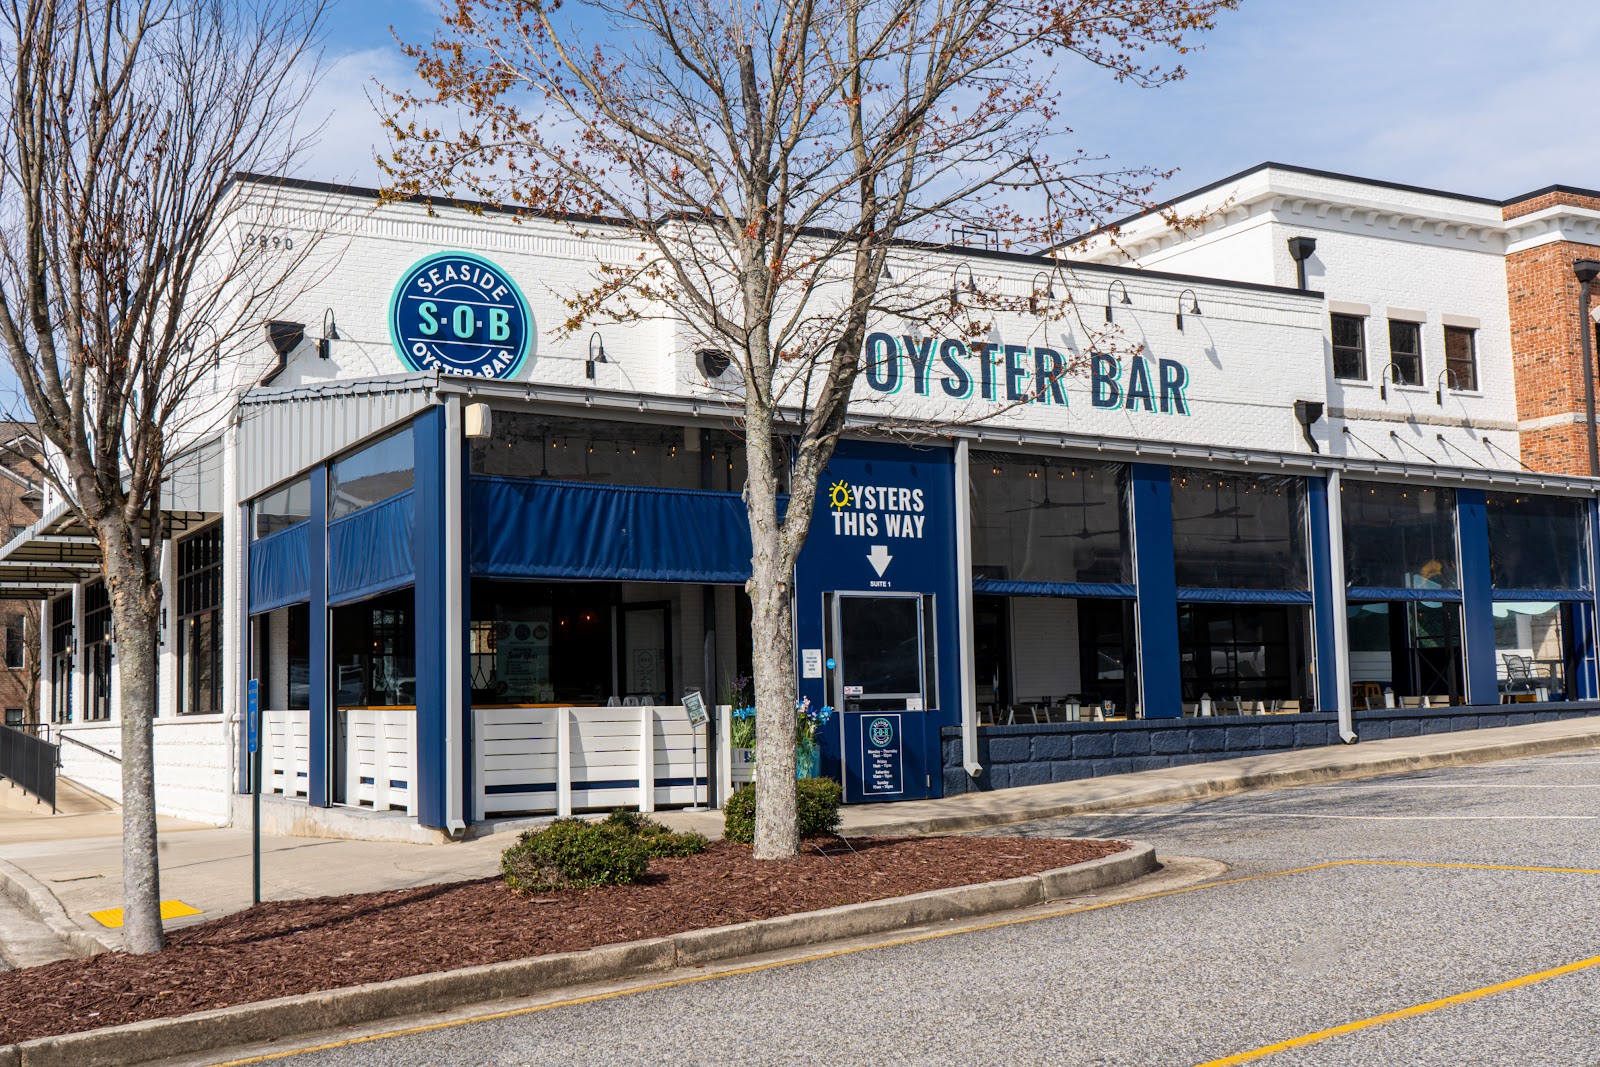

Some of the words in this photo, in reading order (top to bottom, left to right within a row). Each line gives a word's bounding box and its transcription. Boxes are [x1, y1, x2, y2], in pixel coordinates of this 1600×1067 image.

[417, 265, 509, 302] SEASIDE
[481, 350, 514, 378] BAR
[866, 332, 1069, 406] OYSTER
[1091, 352, 1191, 416] BAR
[829, 480, 925, 512] OYSTERS
[831, 511, 879, 537] THIS
[884, 513, 925, 539] WAY
